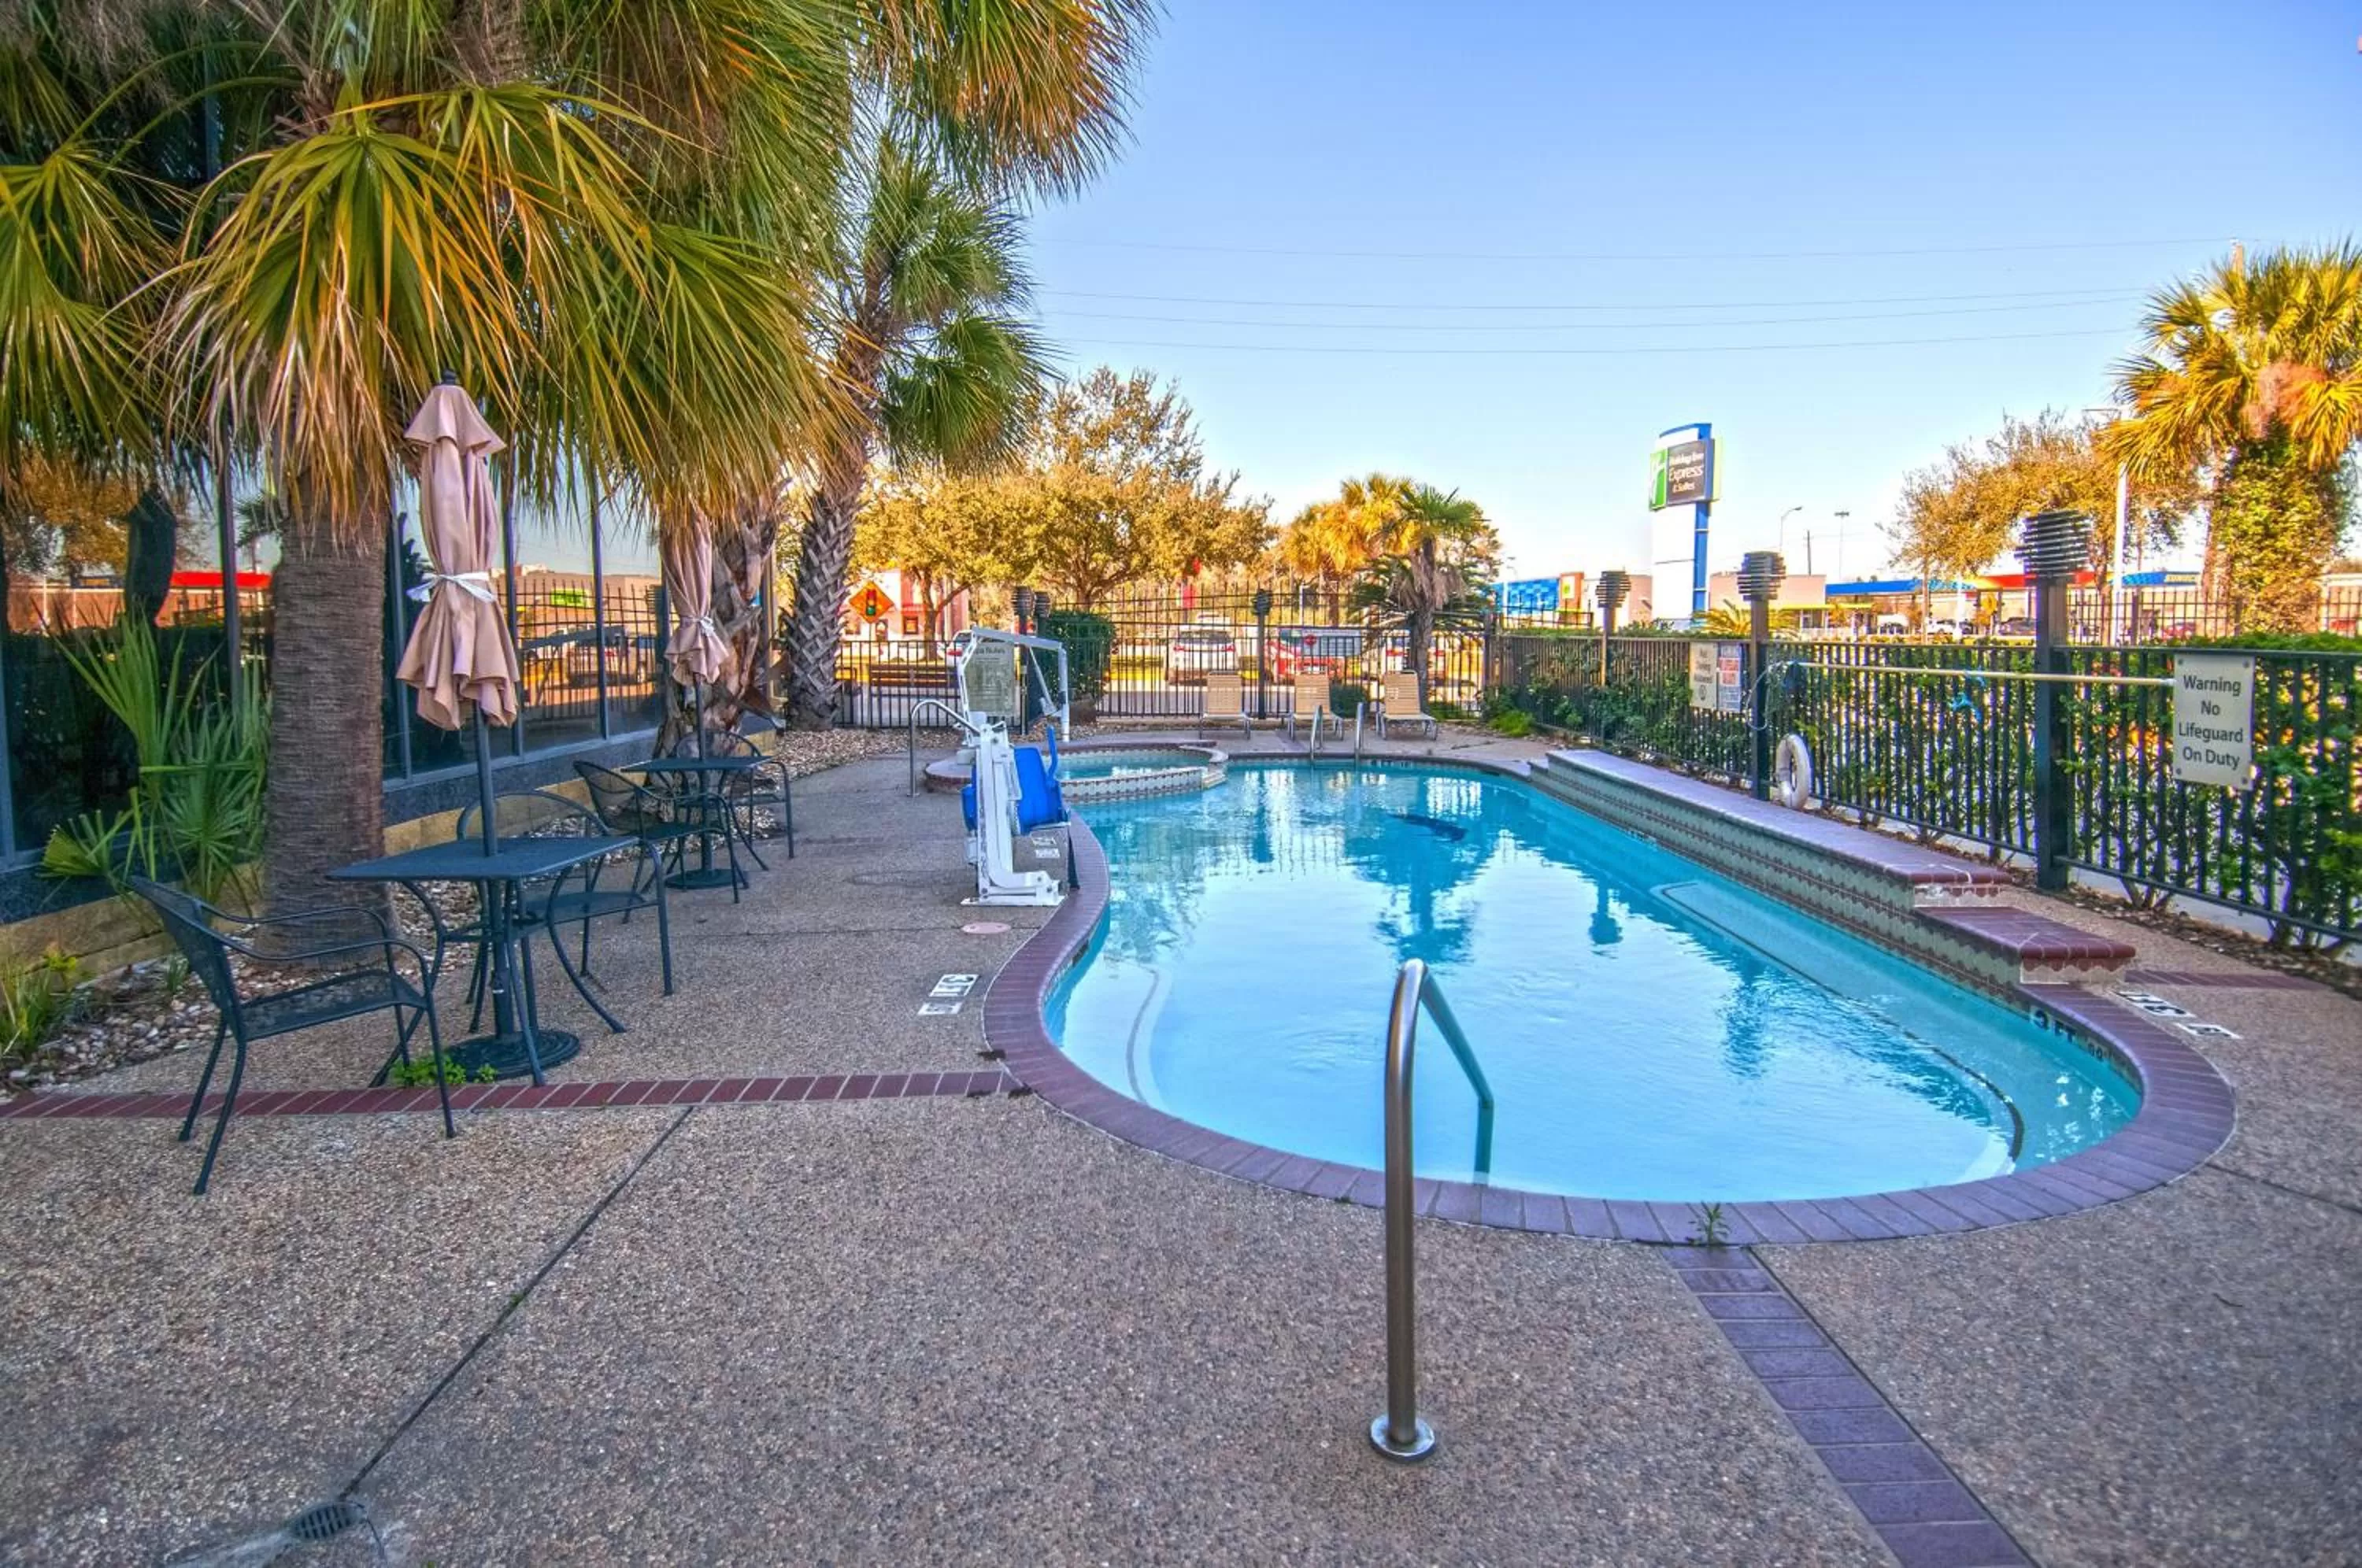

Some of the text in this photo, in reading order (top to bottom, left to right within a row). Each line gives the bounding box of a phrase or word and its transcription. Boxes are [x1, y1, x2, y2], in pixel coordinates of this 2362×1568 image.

[1669, 465, 1704, 482] Express
[2183, 675, 2242, 697] Warning
[2201, 701, 2221, 716] No
[2179, 723, 2244, 743] Lifeguard
[2182, 746, 2241, 770] On Duty
[2033, 1010, 2049, 1030] 3
[2054, 1020, 2076, 1043] FT
